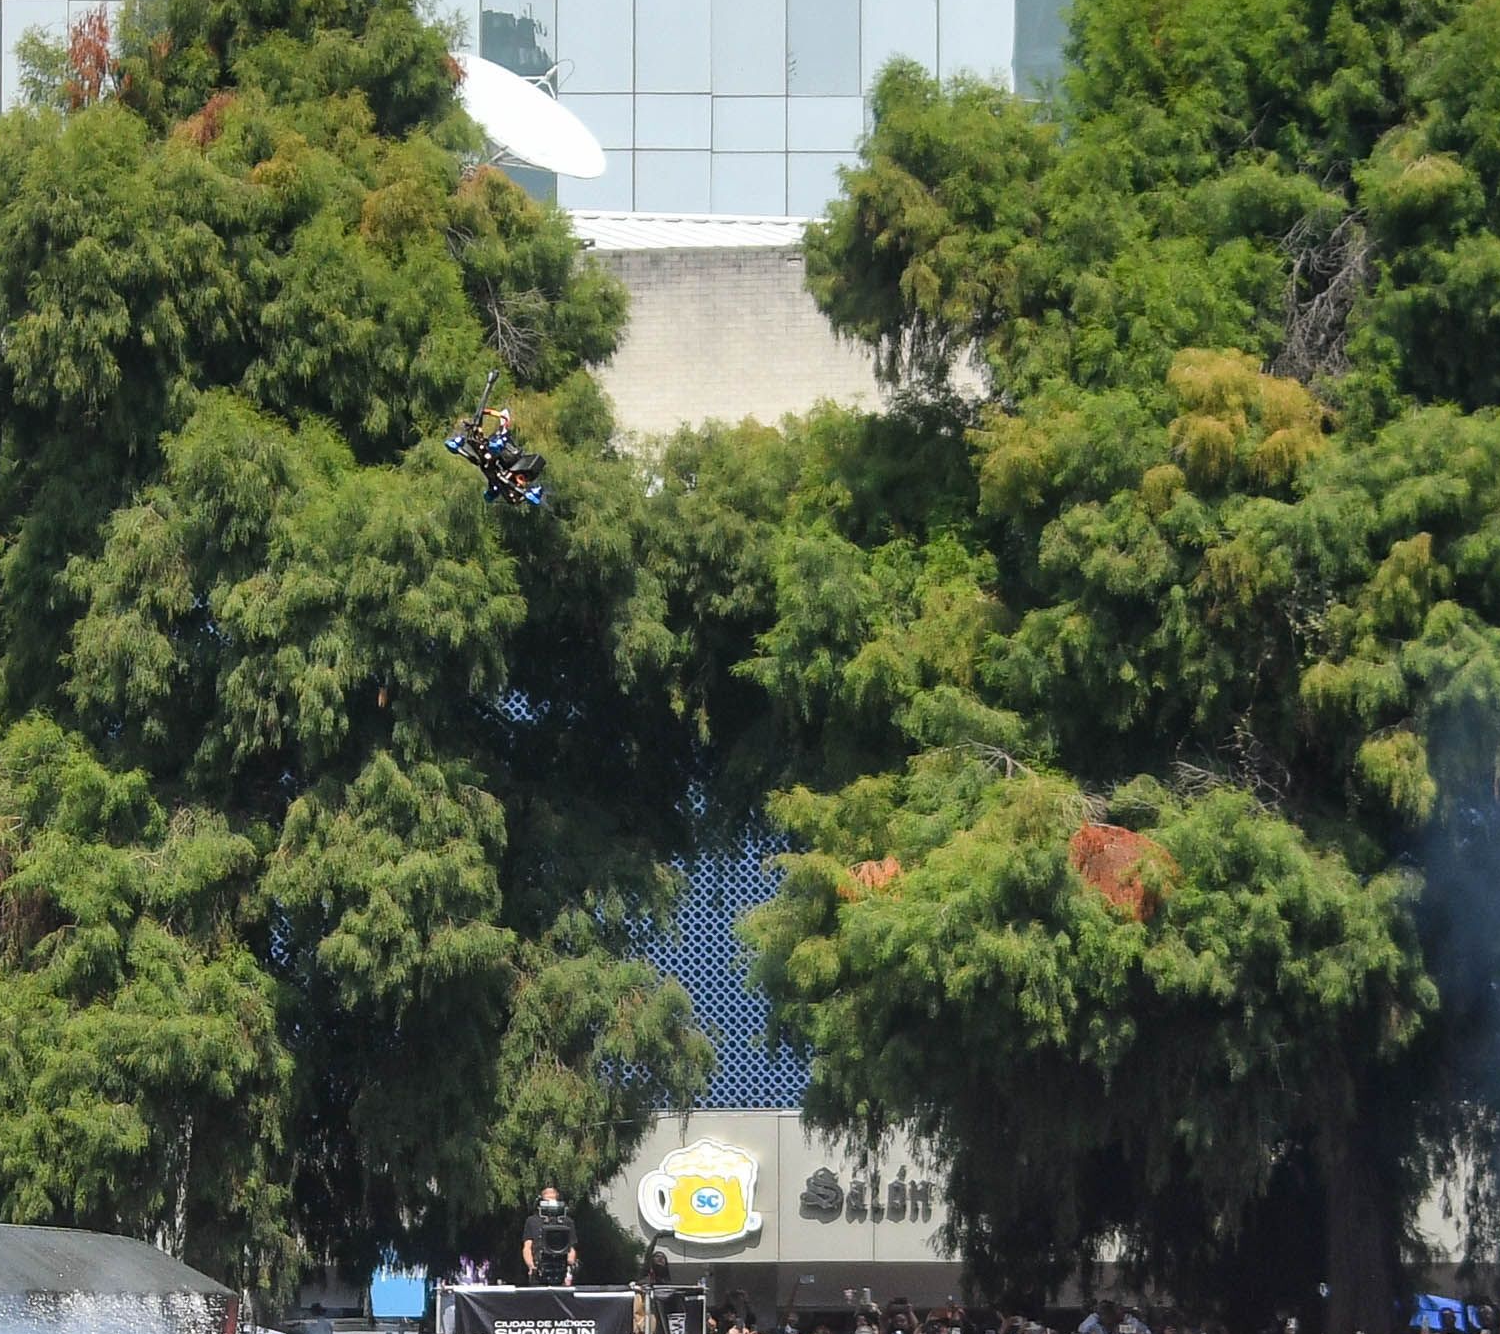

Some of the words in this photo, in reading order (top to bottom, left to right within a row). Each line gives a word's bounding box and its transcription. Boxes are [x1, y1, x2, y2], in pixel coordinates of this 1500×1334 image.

[696, 1193, 719, 1208] SC
[799, 1165, 934, 1224] Salón
[494, 1320, 534, 1328] CIUDAD
[536, 1320, 552, 1328] DE
[554, 1319, 596, 1327] MÉXICO
